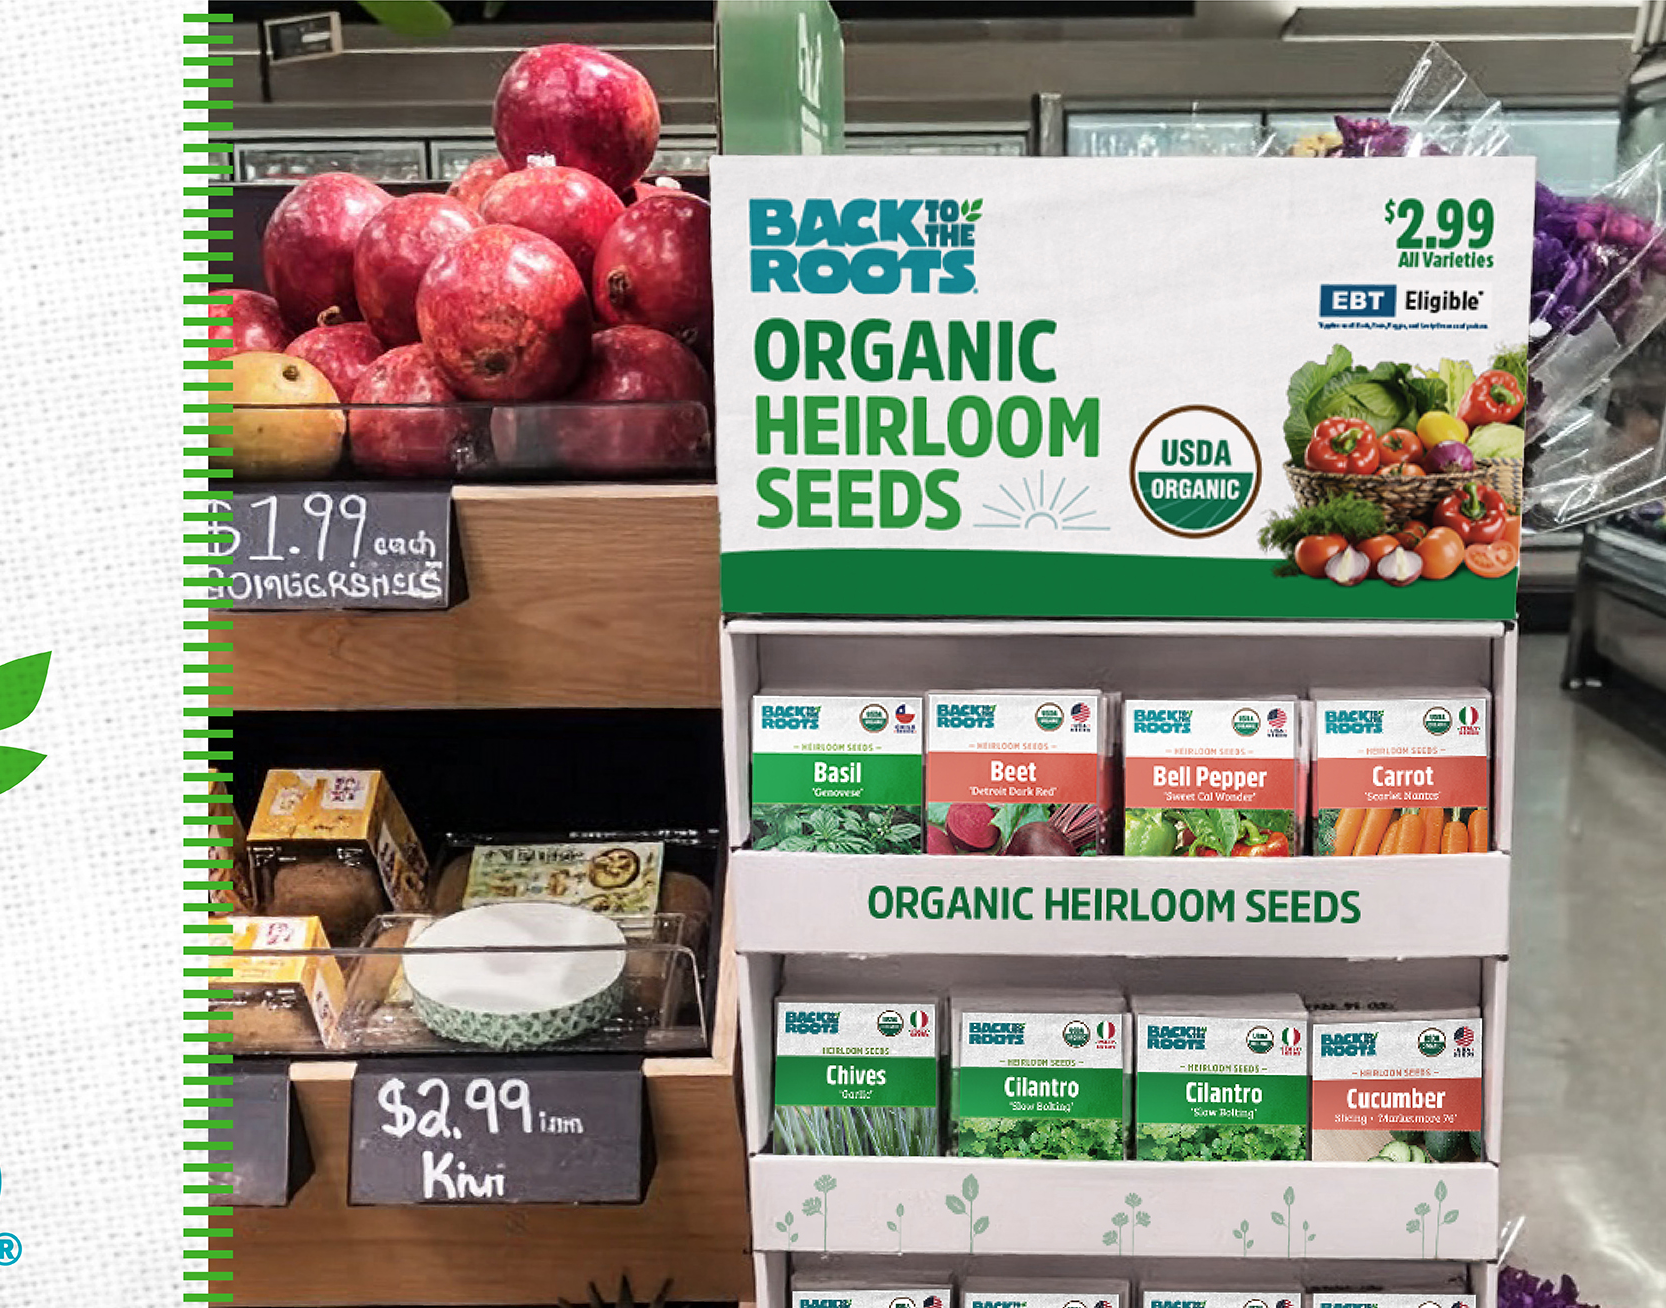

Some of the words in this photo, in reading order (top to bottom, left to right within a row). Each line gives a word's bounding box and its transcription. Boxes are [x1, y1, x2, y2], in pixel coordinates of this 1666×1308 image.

[749, 198, 929, 247] BACK
[924, 201, 960, 221] TO
[924, 223, 975, 247] THE
[1384, 198, 1495, 251] $2.99
[750, 249, 976, 294] ROOTS
[1398, 252, 1418, 269] All
[1422, 252, 1494, 269] Varieties
[1332, 291, 1386, 311] EBT
[754, 319, 1057, 383] ORGANIC
[756, 396, 1100, 457] HEIRLOOM
[1160, 439, 1232, 468] USDA
[756, 468, 962, 529] SEEDS
[1151, 476, 1241, 501] ORGANIC
[813, 762, 862, 783] Basil
[991, 760, 1037, 782] Beet
[1153, 766, 1190, 787] Bell
[1196, 768, 1267, 791] Pepper
[1373, 766, 1434, 787] Carrot
[868, 885, 1033, 920] ORGANIC
[1046, 887, 1235, 923] HEIRLOOM
[1246, 889, 1361, 924] SEEDS
[826, 1065, 886, 1086] Chives
[1004, 1077, 1079, 1098] Cilantro
[1186, 1082, 1263, 1103] Cilantro
[1347, 1088, 1446, 1109] Cucumber
[377, 1077, 532, 1139] $2.99
